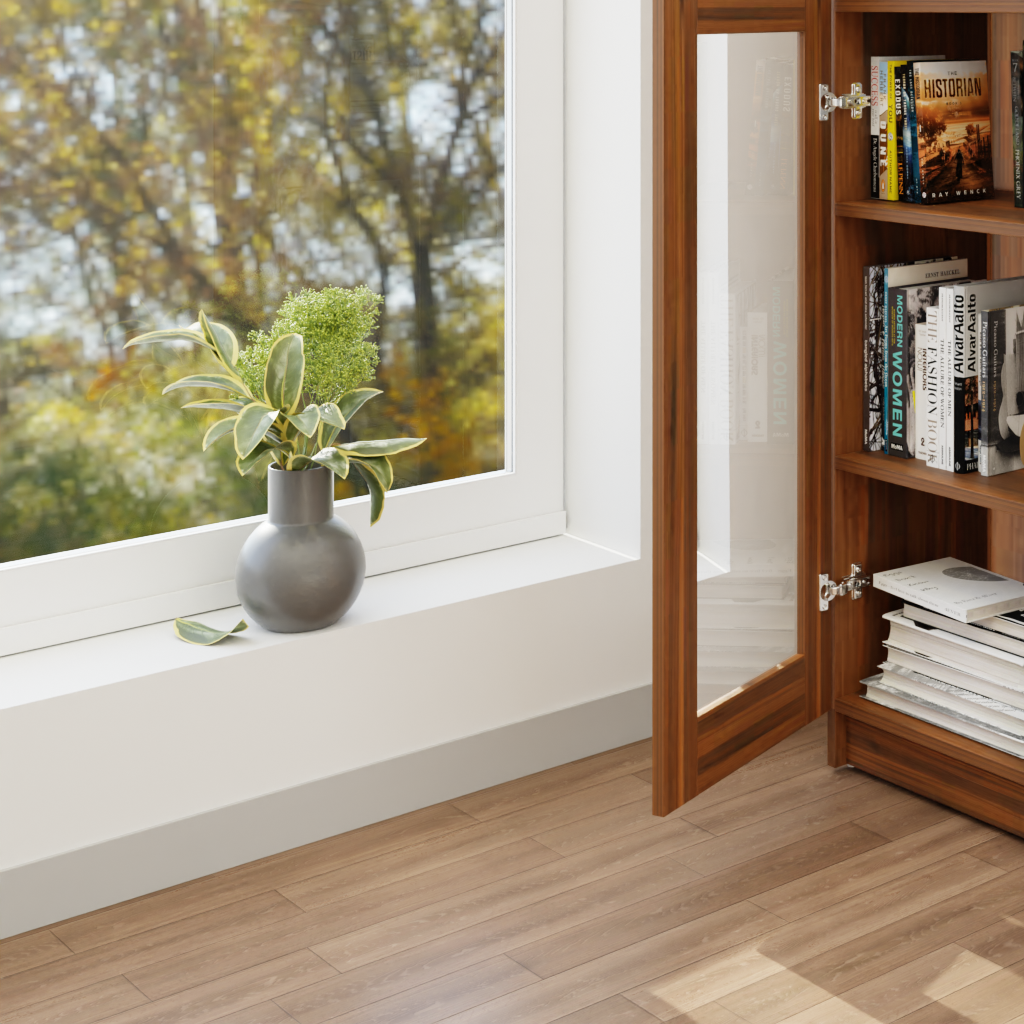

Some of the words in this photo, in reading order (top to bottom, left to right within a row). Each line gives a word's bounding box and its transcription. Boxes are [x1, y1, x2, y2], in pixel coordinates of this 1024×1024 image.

[1013, 62, 1018, 72] 7
[924, 78, 981, 98] HISTORIAN
[928, 311, 937, 343] THE
[954, 295, 964, 334] Aalto
[968, 294, 976, 332] Aalto
[954, 334, 963, 374] Alvar
[968, 334, 976, 372] Alvar
[892, 350, 903, 438] WOMEN
[928, 347, 937, 415] FASHION
[940, 386, 944, 398] OF
[948, 388, 951, 398] OF
[891, 443, 903, 451] MoMA
[928, 419, 937, 462] BOOK
